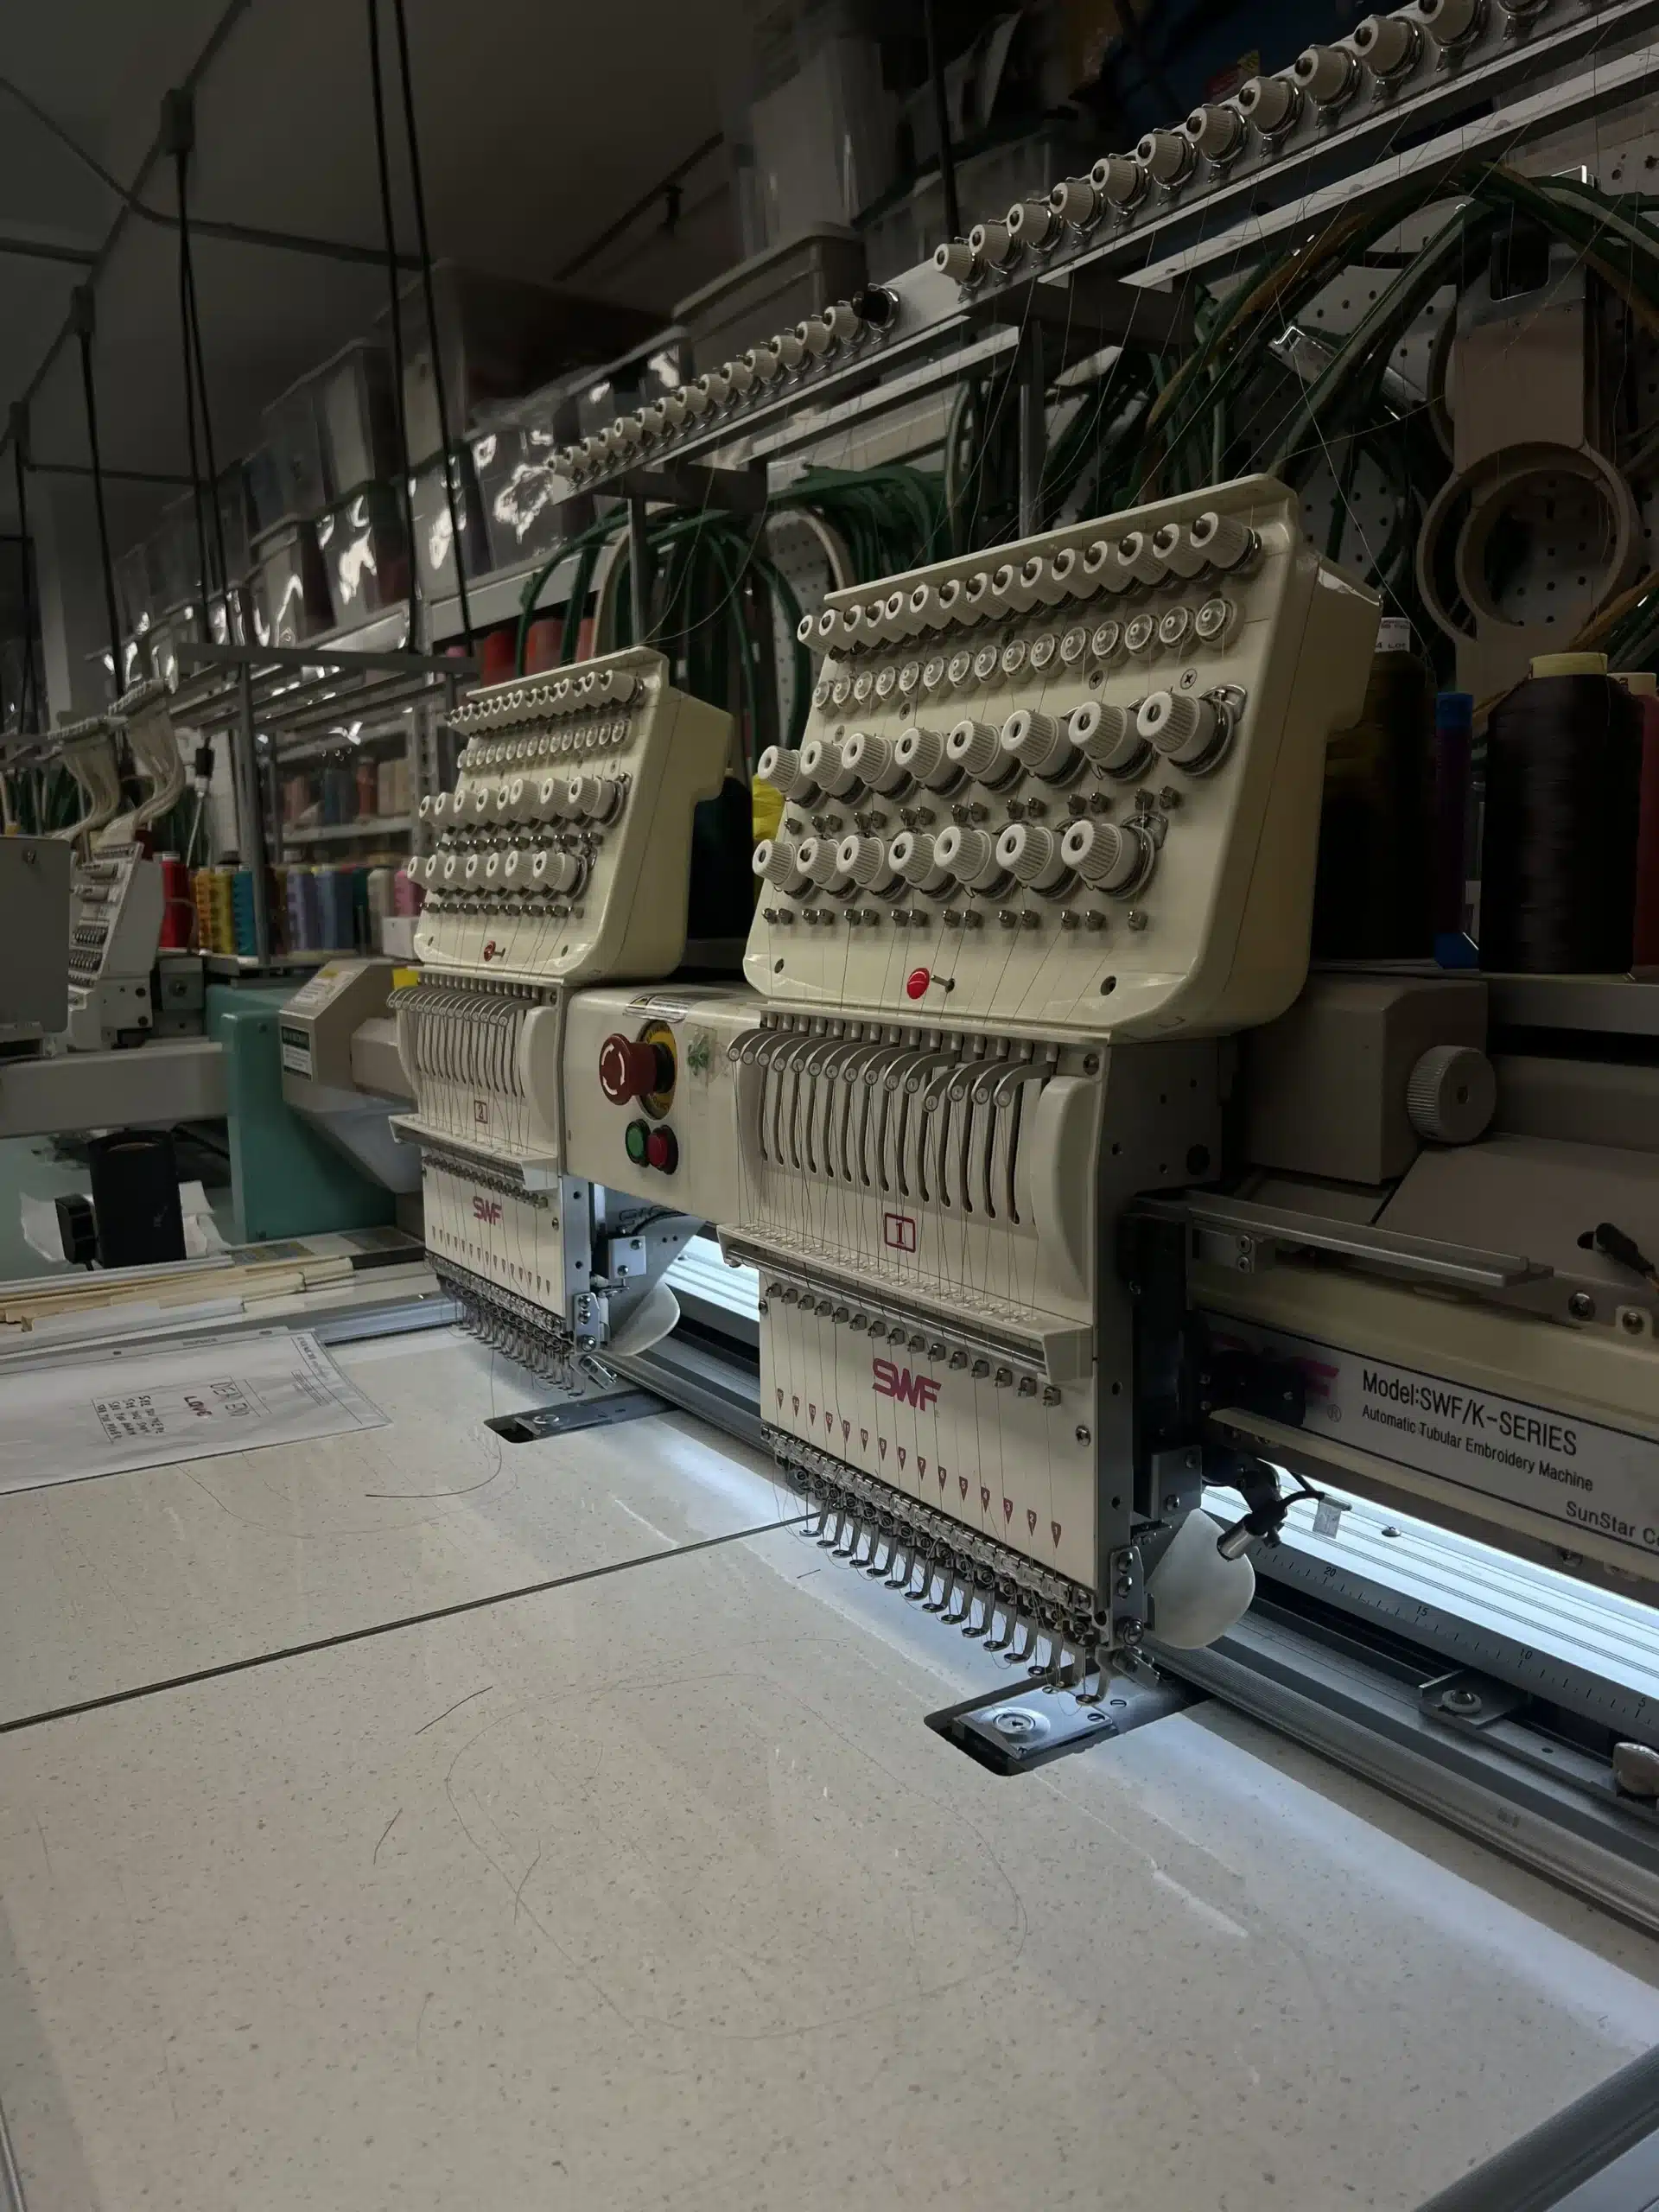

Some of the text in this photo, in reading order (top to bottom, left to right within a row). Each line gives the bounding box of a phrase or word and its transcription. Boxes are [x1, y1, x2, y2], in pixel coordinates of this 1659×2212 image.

[473, 1196, 502, 1225] SWF
[872, 1357, 943, 1412] SWF
[1363, 1369, 1577, 1456] Model:SWF/K-SERIES
[1362, 1404, 1594, 1492] Automatic Tubular Embroidery Machine
[1566, 1500, 1659, 1547] SunStar C
[1324, 1566, 1338, 1578] 20
[1416, 1605, 1430, 1617] 15
[1520, 1648, 1533, 1660] 10
[1637, 1696, 1646, 1708] 5
